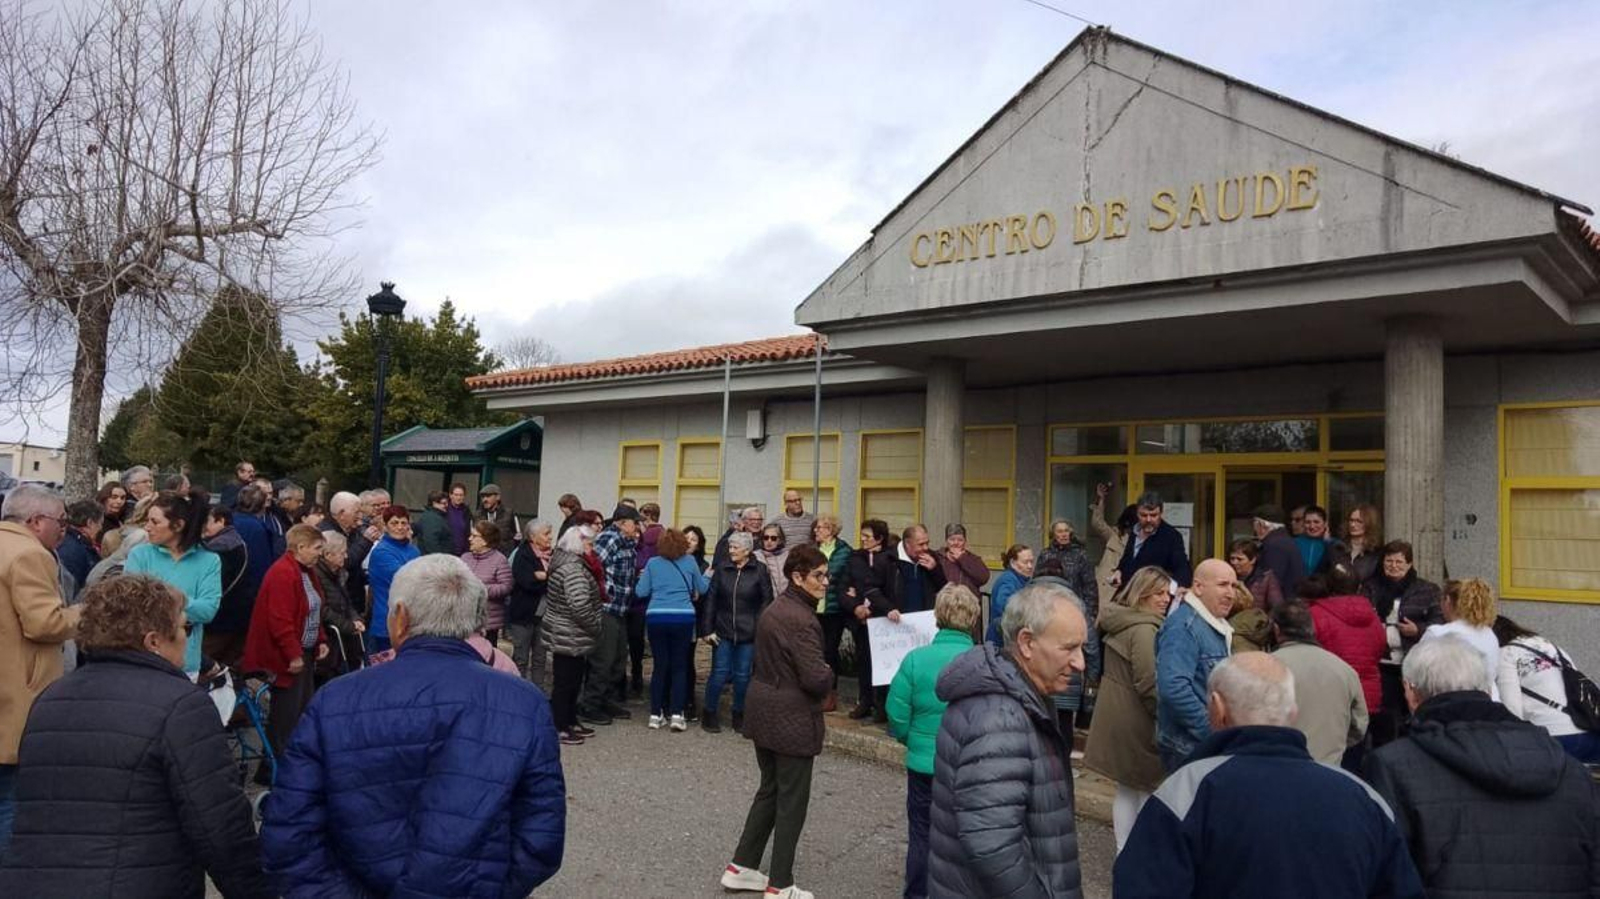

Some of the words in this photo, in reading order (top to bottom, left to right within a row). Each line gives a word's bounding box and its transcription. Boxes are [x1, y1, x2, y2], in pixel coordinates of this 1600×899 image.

[909, 209, 1057, 268] CENTRO
[1073, 197, 1131, 245] DE
[1147, 164, 1320, 232] SAUDE
